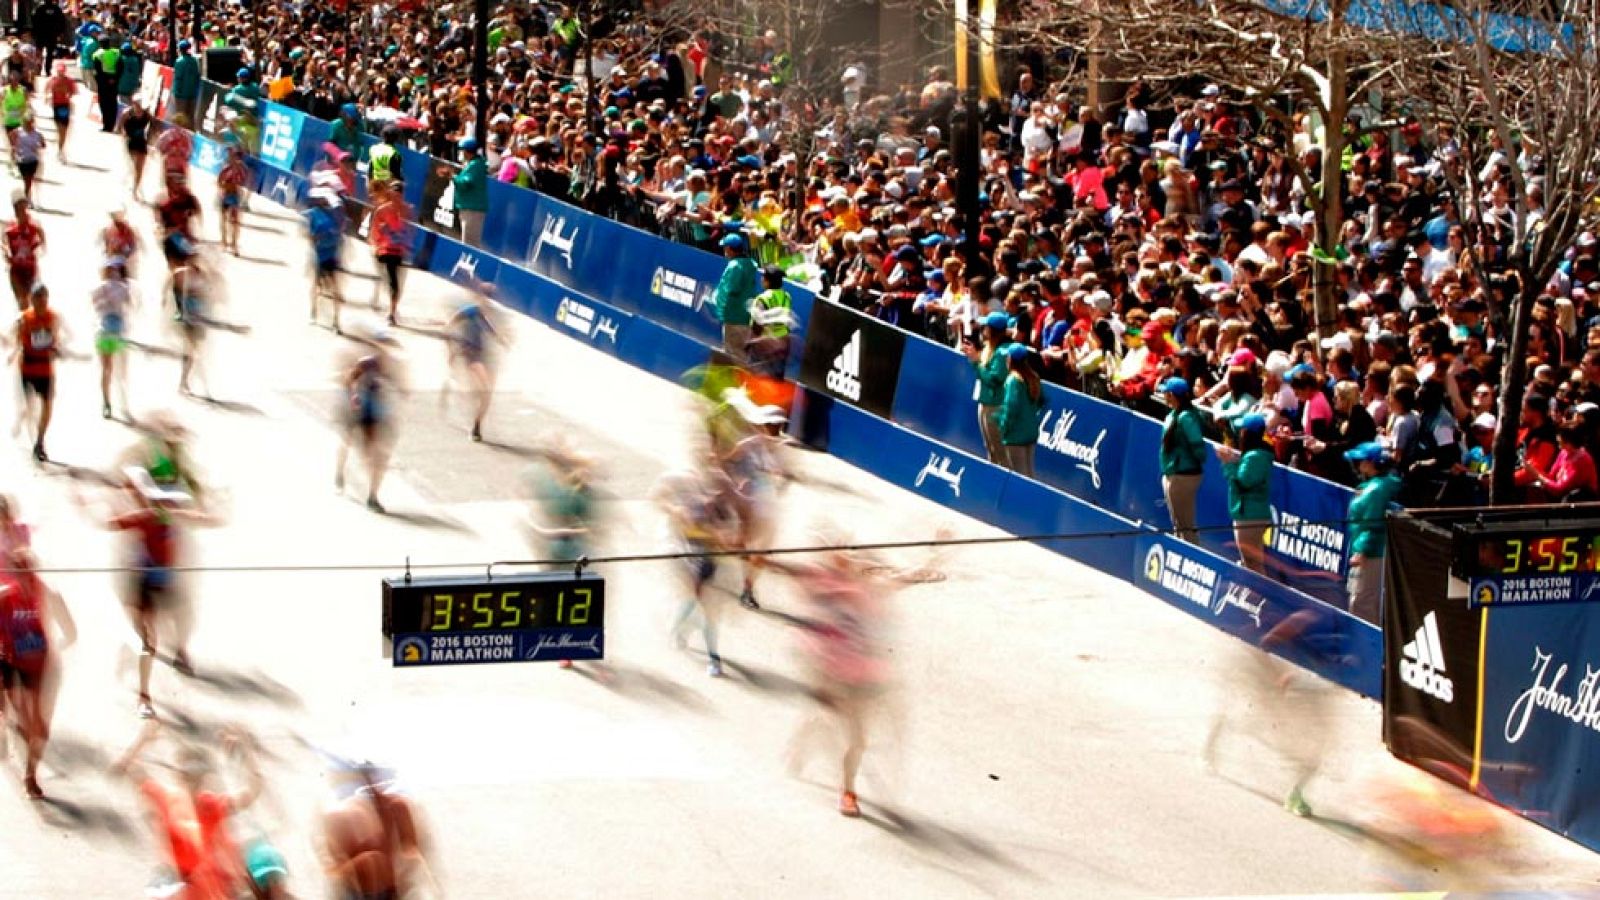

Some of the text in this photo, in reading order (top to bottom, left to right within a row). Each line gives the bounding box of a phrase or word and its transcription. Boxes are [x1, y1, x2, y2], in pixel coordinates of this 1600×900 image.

[826, 361, 862, 402] adidas
[1281, 511, 1345, 551] THE BOSTON
[1165, 550, 1217, 588] THE BOSTON
[1277, 532, 1342, 573] MARATHON
[1162, 569, 1212, 608] MARATHON
[1502, 589, 1571, 601] MARATHON
[1503, 579, 1527, 590] 2016
[1529, 577, 1571, 589] BOSTON
[431, 588, 592, 630] 3:55:12
[431, 634, 513, 648] 2016 BOSTON
[431, 647, 513, 661] MARATHON
[1399, 657, 1453, 703] adidas
[1505, 645, 1572, 743] John
